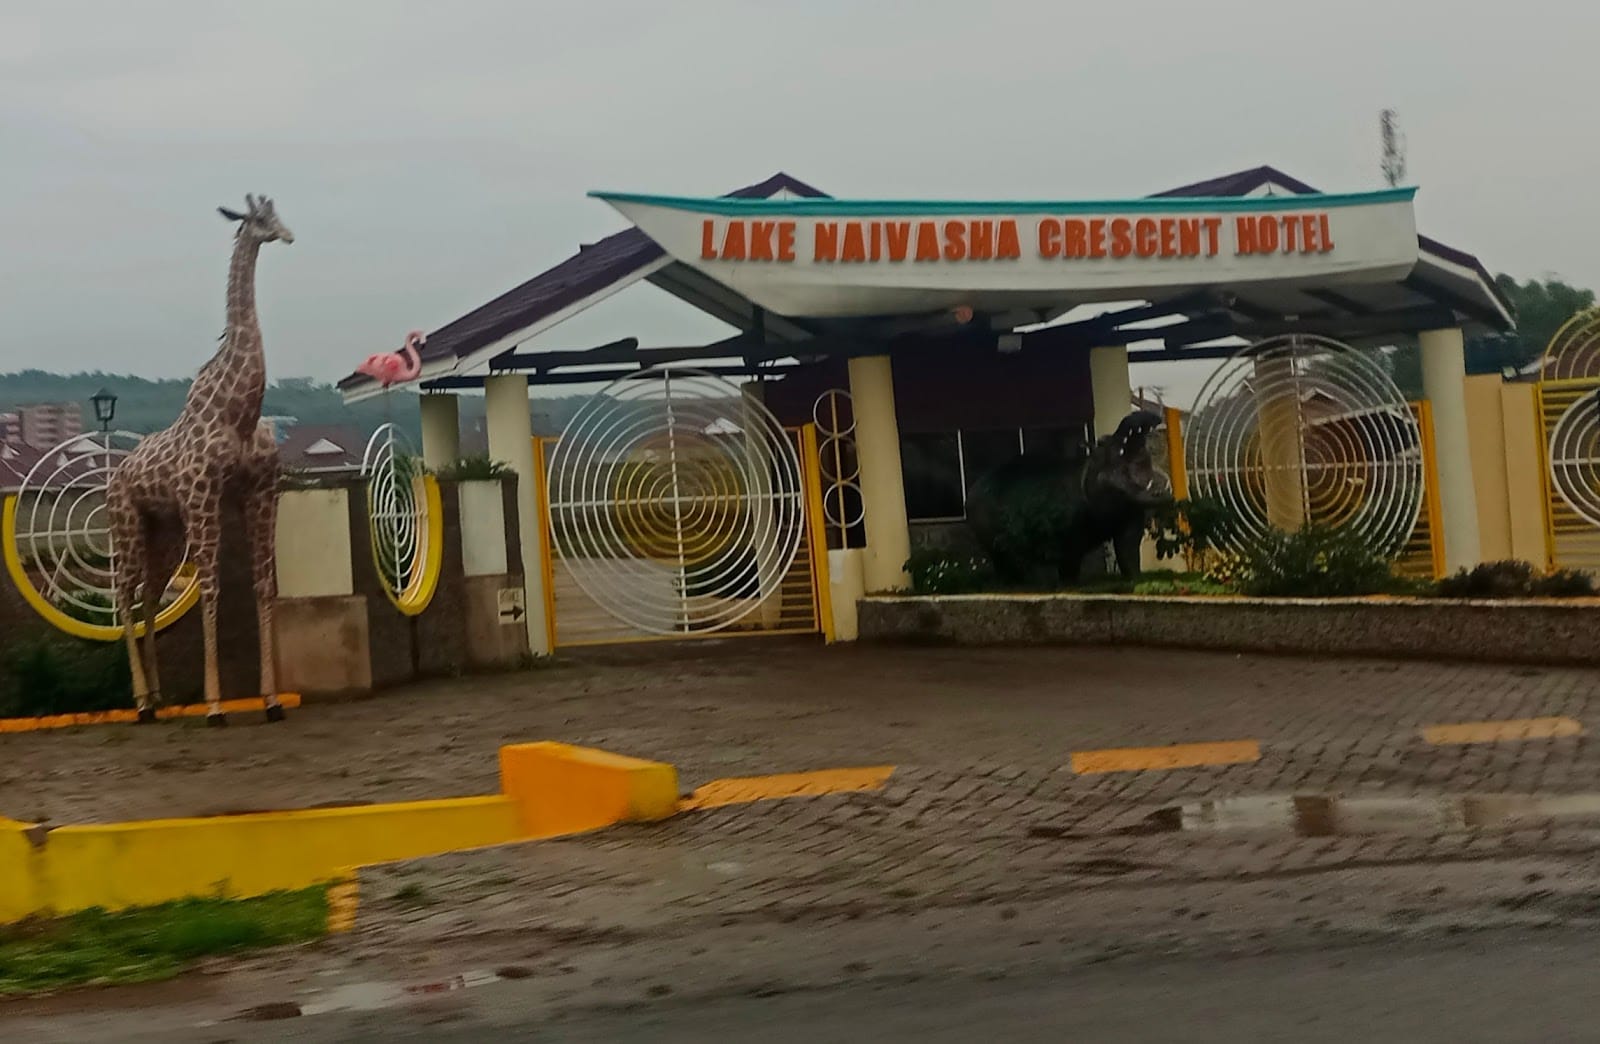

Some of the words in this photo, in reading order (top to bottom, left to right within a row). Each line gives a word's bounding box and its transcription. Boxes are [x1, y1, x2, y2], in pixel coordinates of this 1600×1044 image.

[701, 219, 796, 261] LAKE
[814, 219, 1021, 262] NAIVASHA
[1038, 217, 1222, 258] CRESCENT
[1235, 213, 1334, 254] HOTEL
